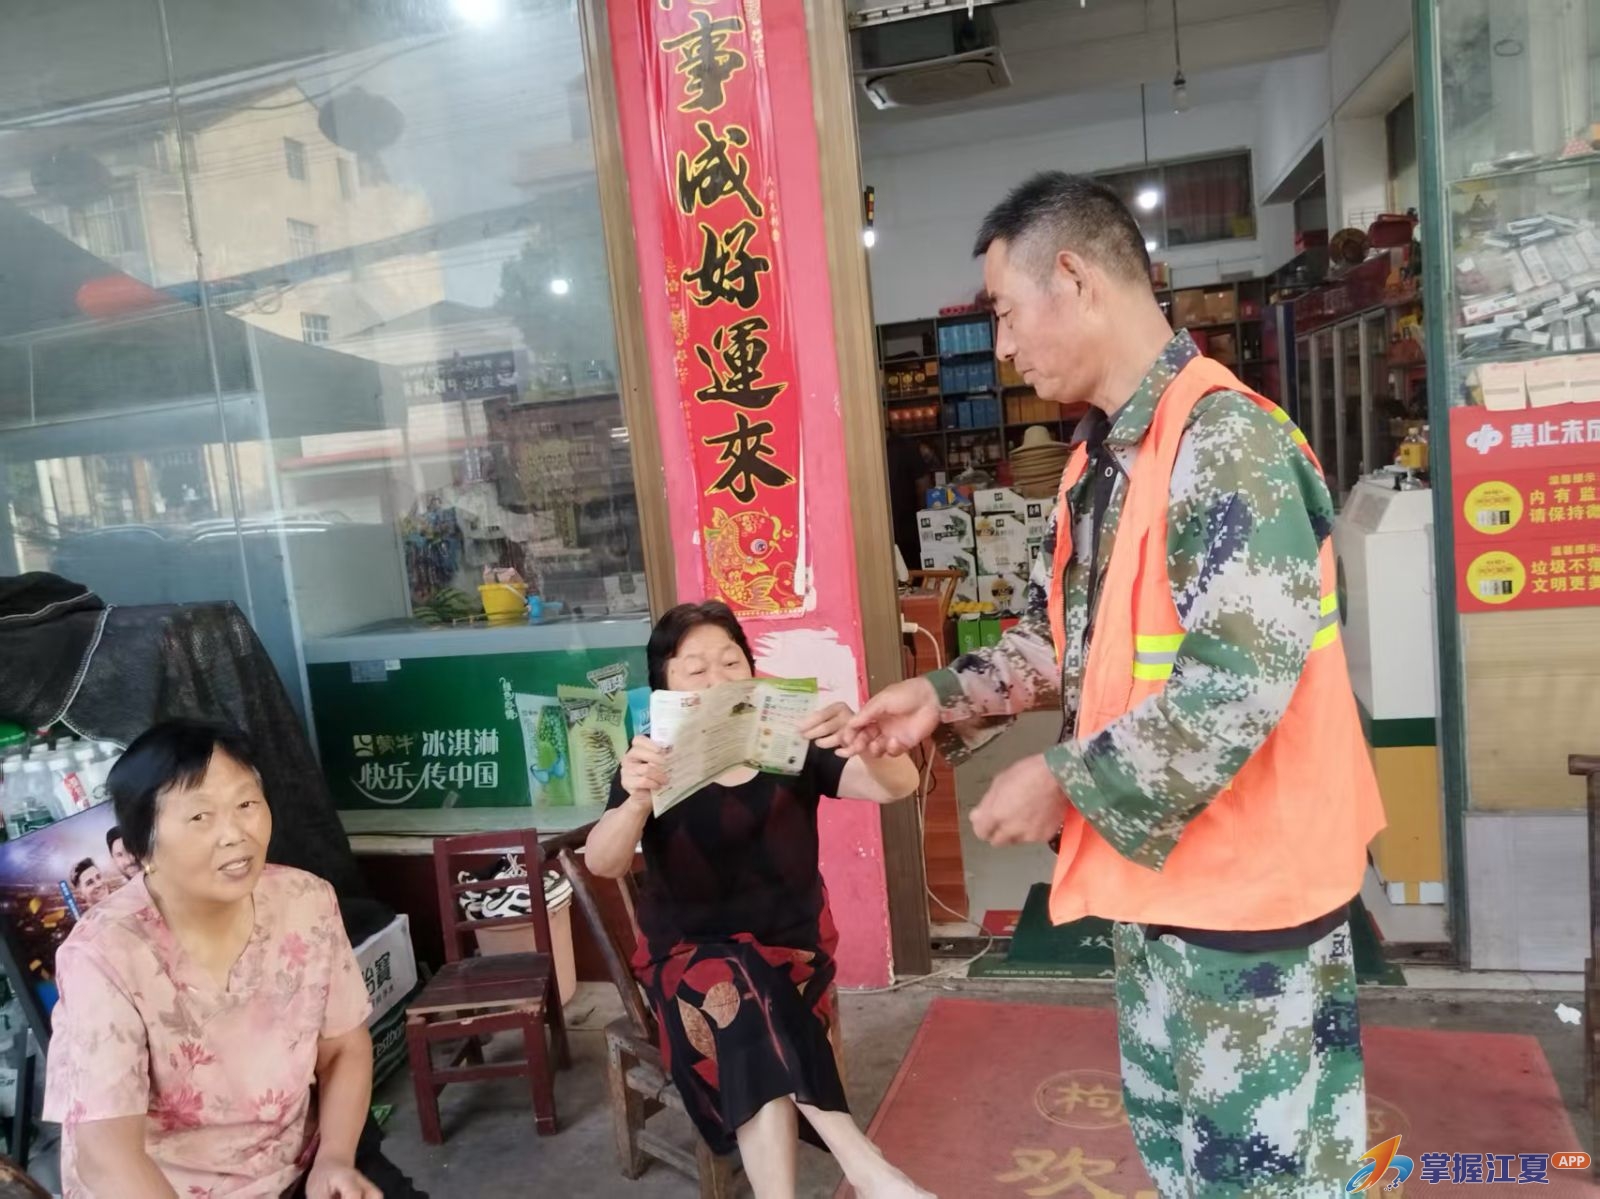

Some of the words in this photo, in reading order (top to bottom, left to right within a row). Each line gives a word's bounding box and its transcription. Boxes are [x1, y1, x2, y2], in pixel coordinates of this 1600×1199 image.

[659, 0, 797, 504] 事成好運來
[421, 727, 500, 757] 冰淇淋
[357, 760, 499, 791] 快乐传中国
